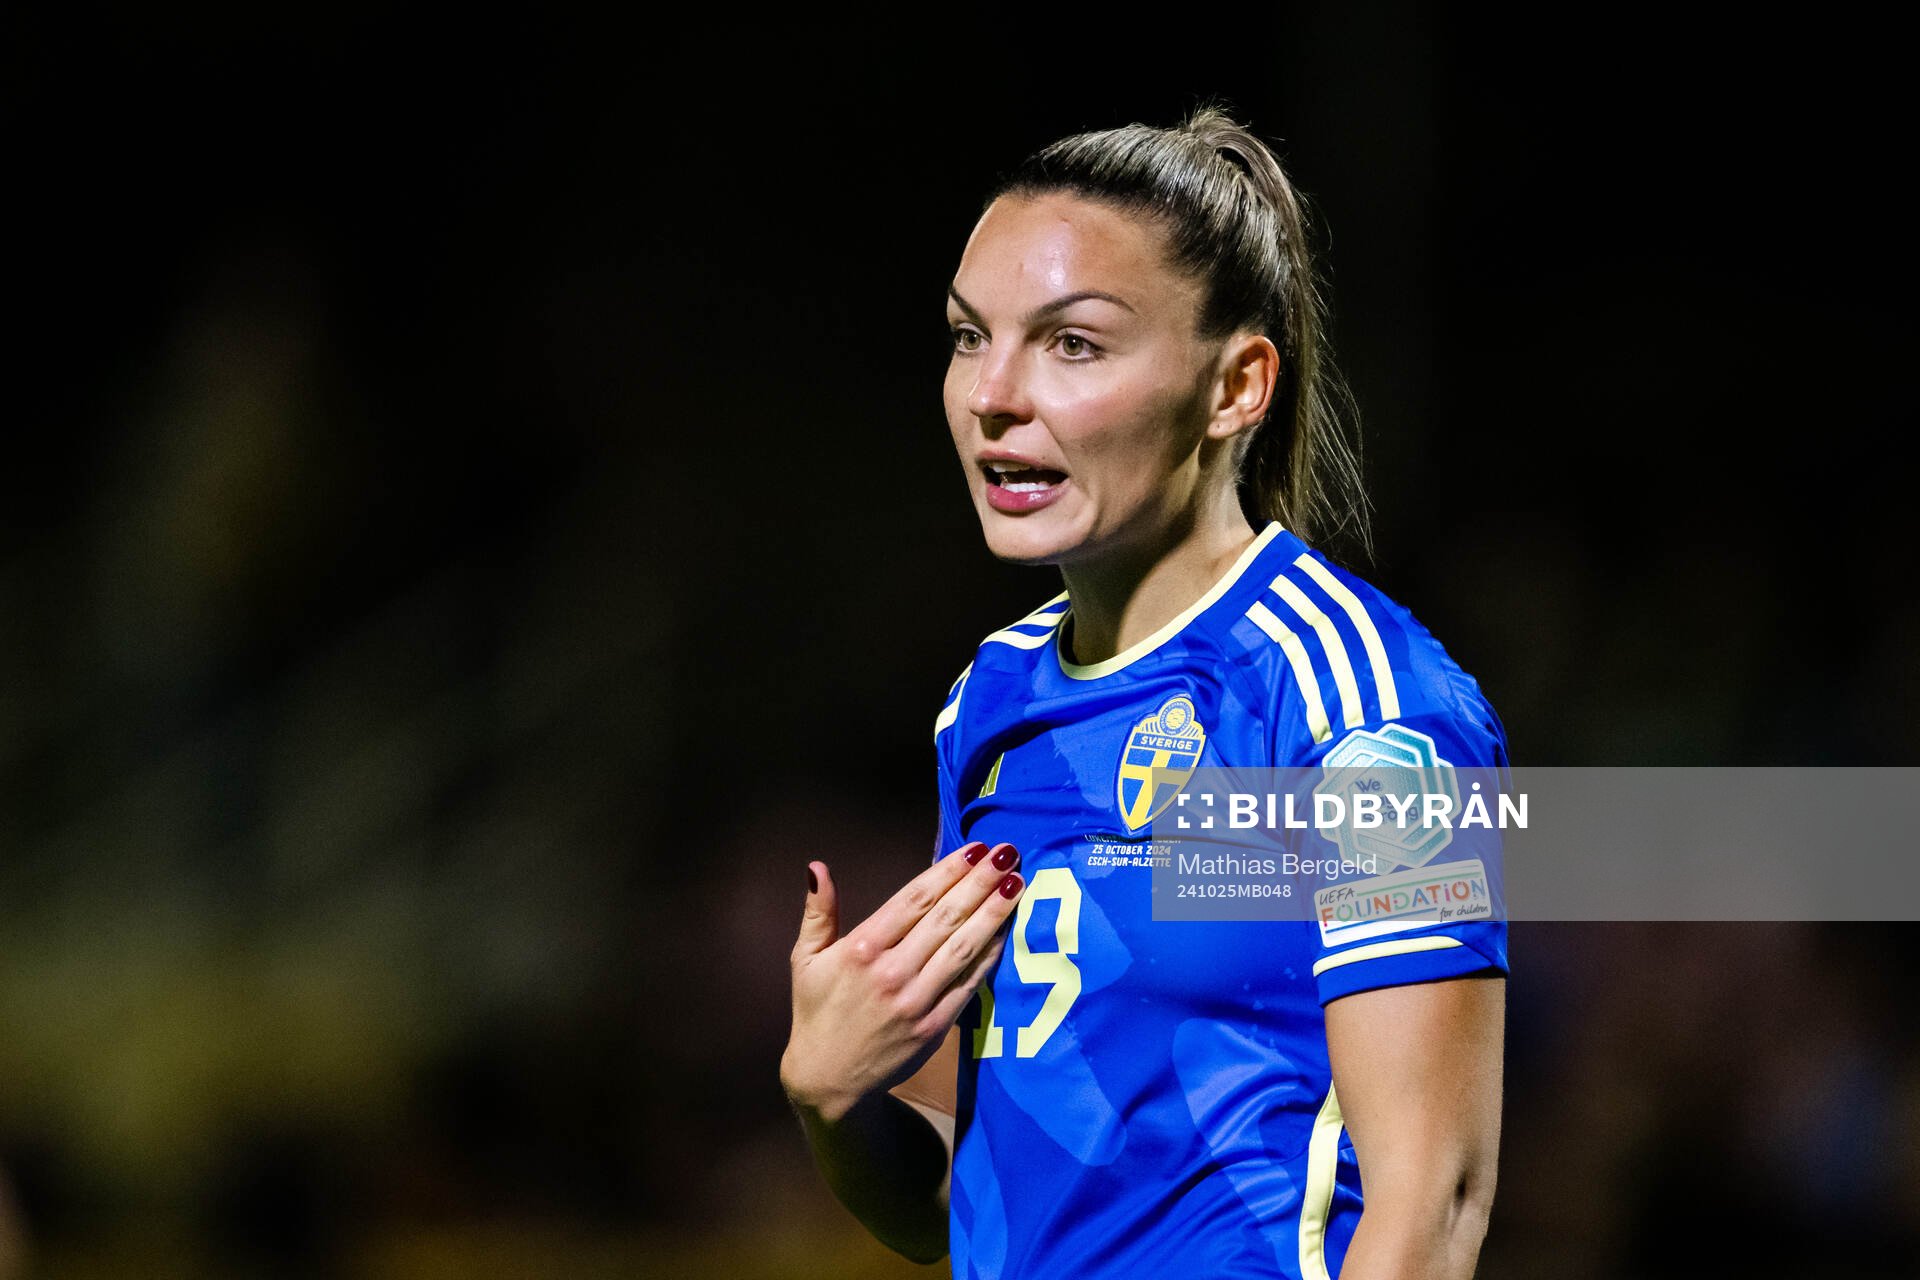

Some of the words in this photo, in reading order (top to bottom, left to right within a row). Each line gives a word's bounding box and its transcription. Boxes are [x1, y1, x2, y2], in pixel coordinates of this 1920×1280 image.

[1140, 735, 1194, 750] SVERIGE
[1355, 778, 1382, 792] We
[1092, 844, 1104, 855] 25
[1105, 845, 1143, 855] OCTOBER
[1146, 845, 1172, 856] 2024
[1087, 856, 1172, 867] ESCH-SUR-ALZETTE
[1319, 887, 1355, 905] UEFA
[1440, 906, 1454, 922] for
[1456, 901, 1489, 916] children
